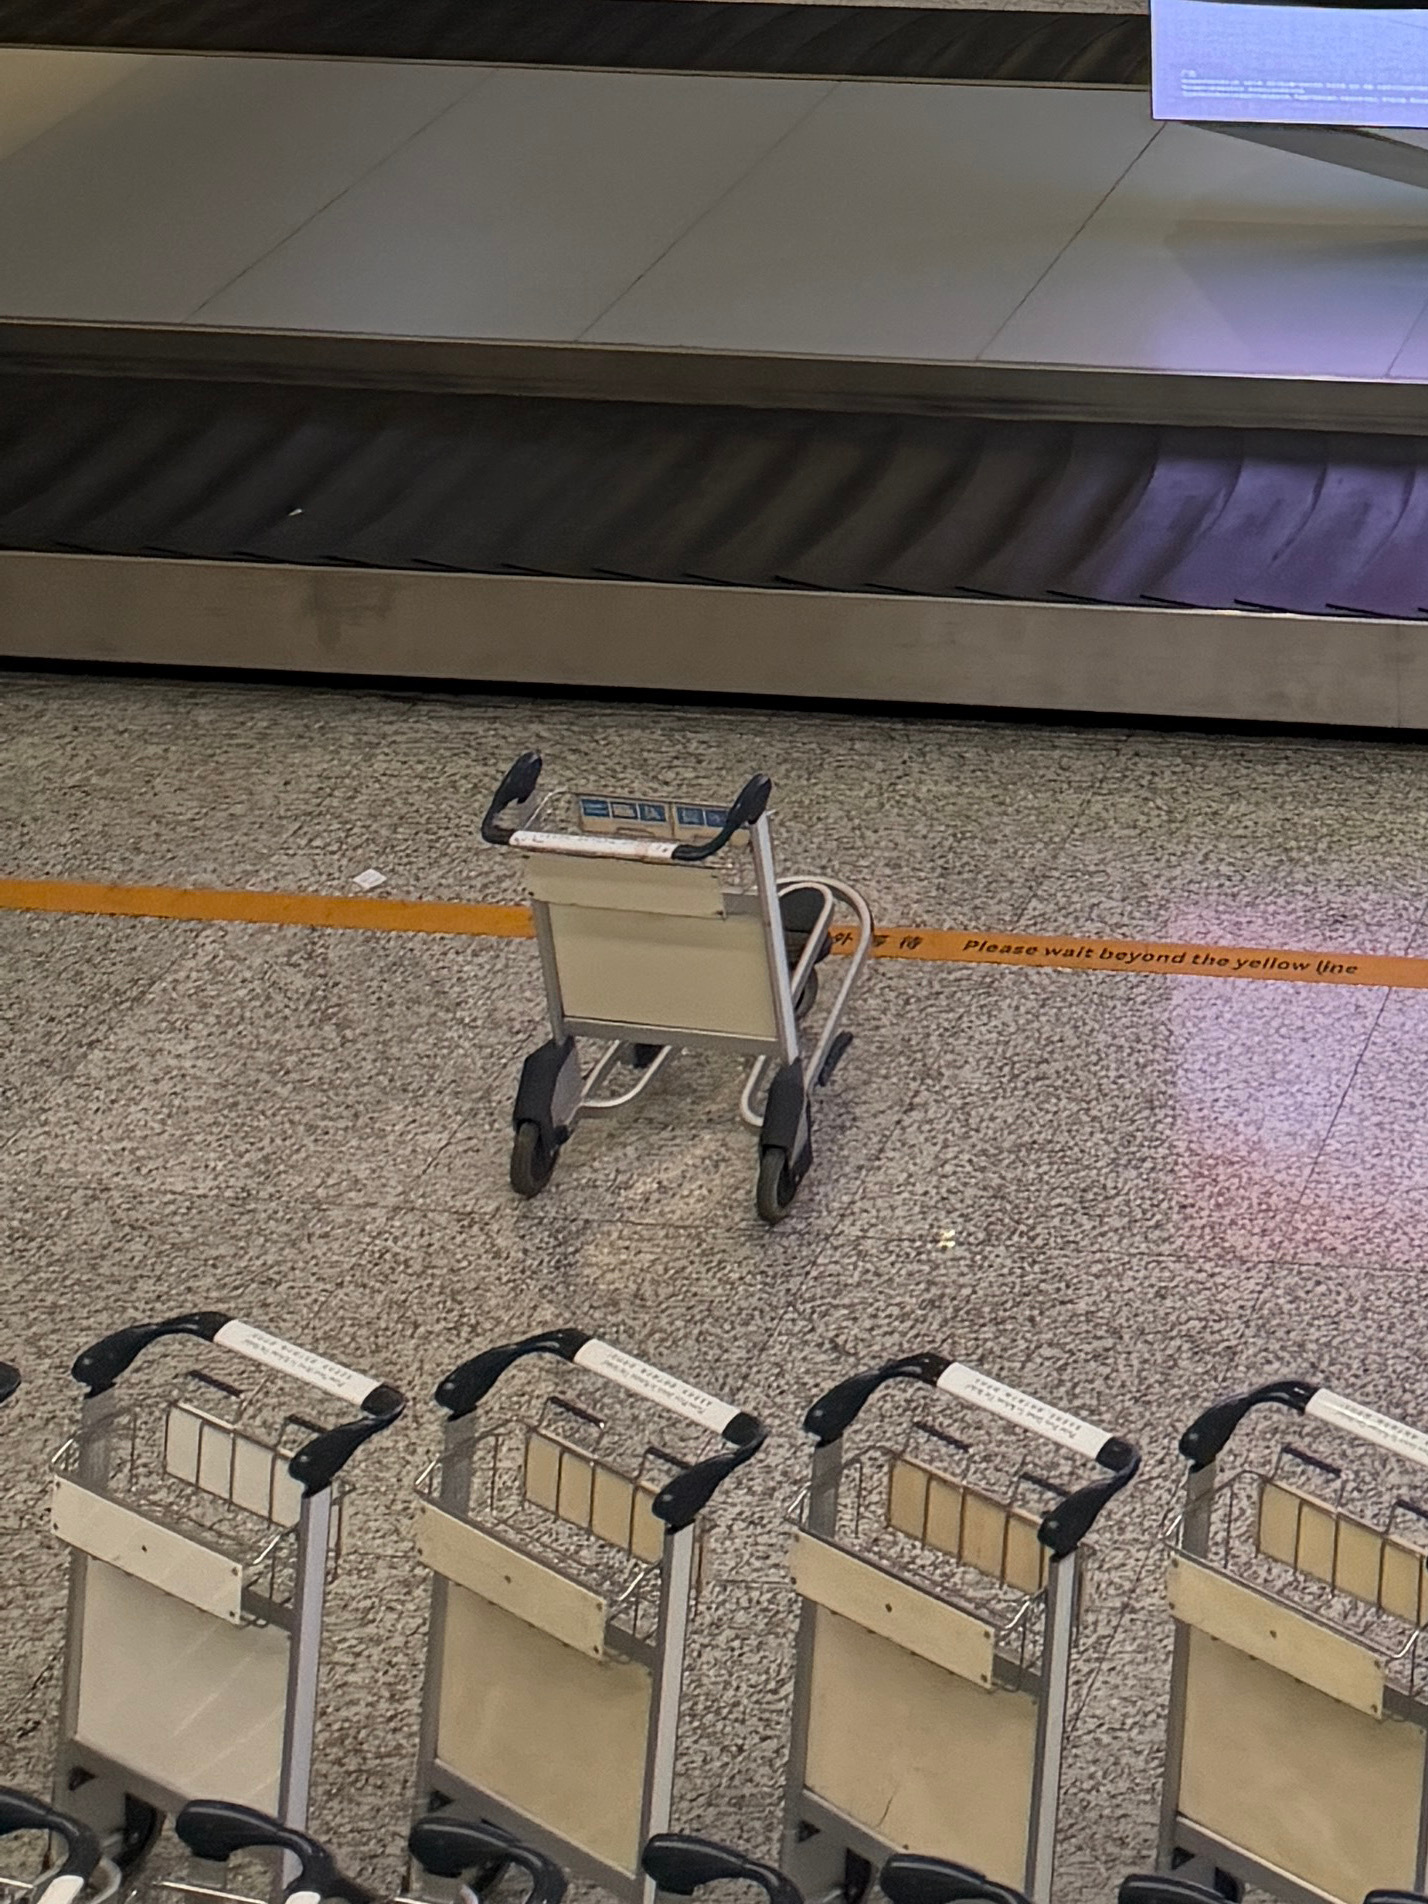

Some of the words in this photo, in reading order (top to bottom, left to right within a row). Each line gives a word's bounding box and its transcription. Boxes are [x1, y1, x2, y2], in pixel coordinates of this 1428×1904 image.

[962, 939, 1038, 956] Please
[1045, 947, 1093, 959] wait
[1099, 948, 1185, 966] beyond
[1193, 953, 1230, 968] the
[1233, 956, 1309, 973] yellow
[1315, 959, 1358, 976] line
